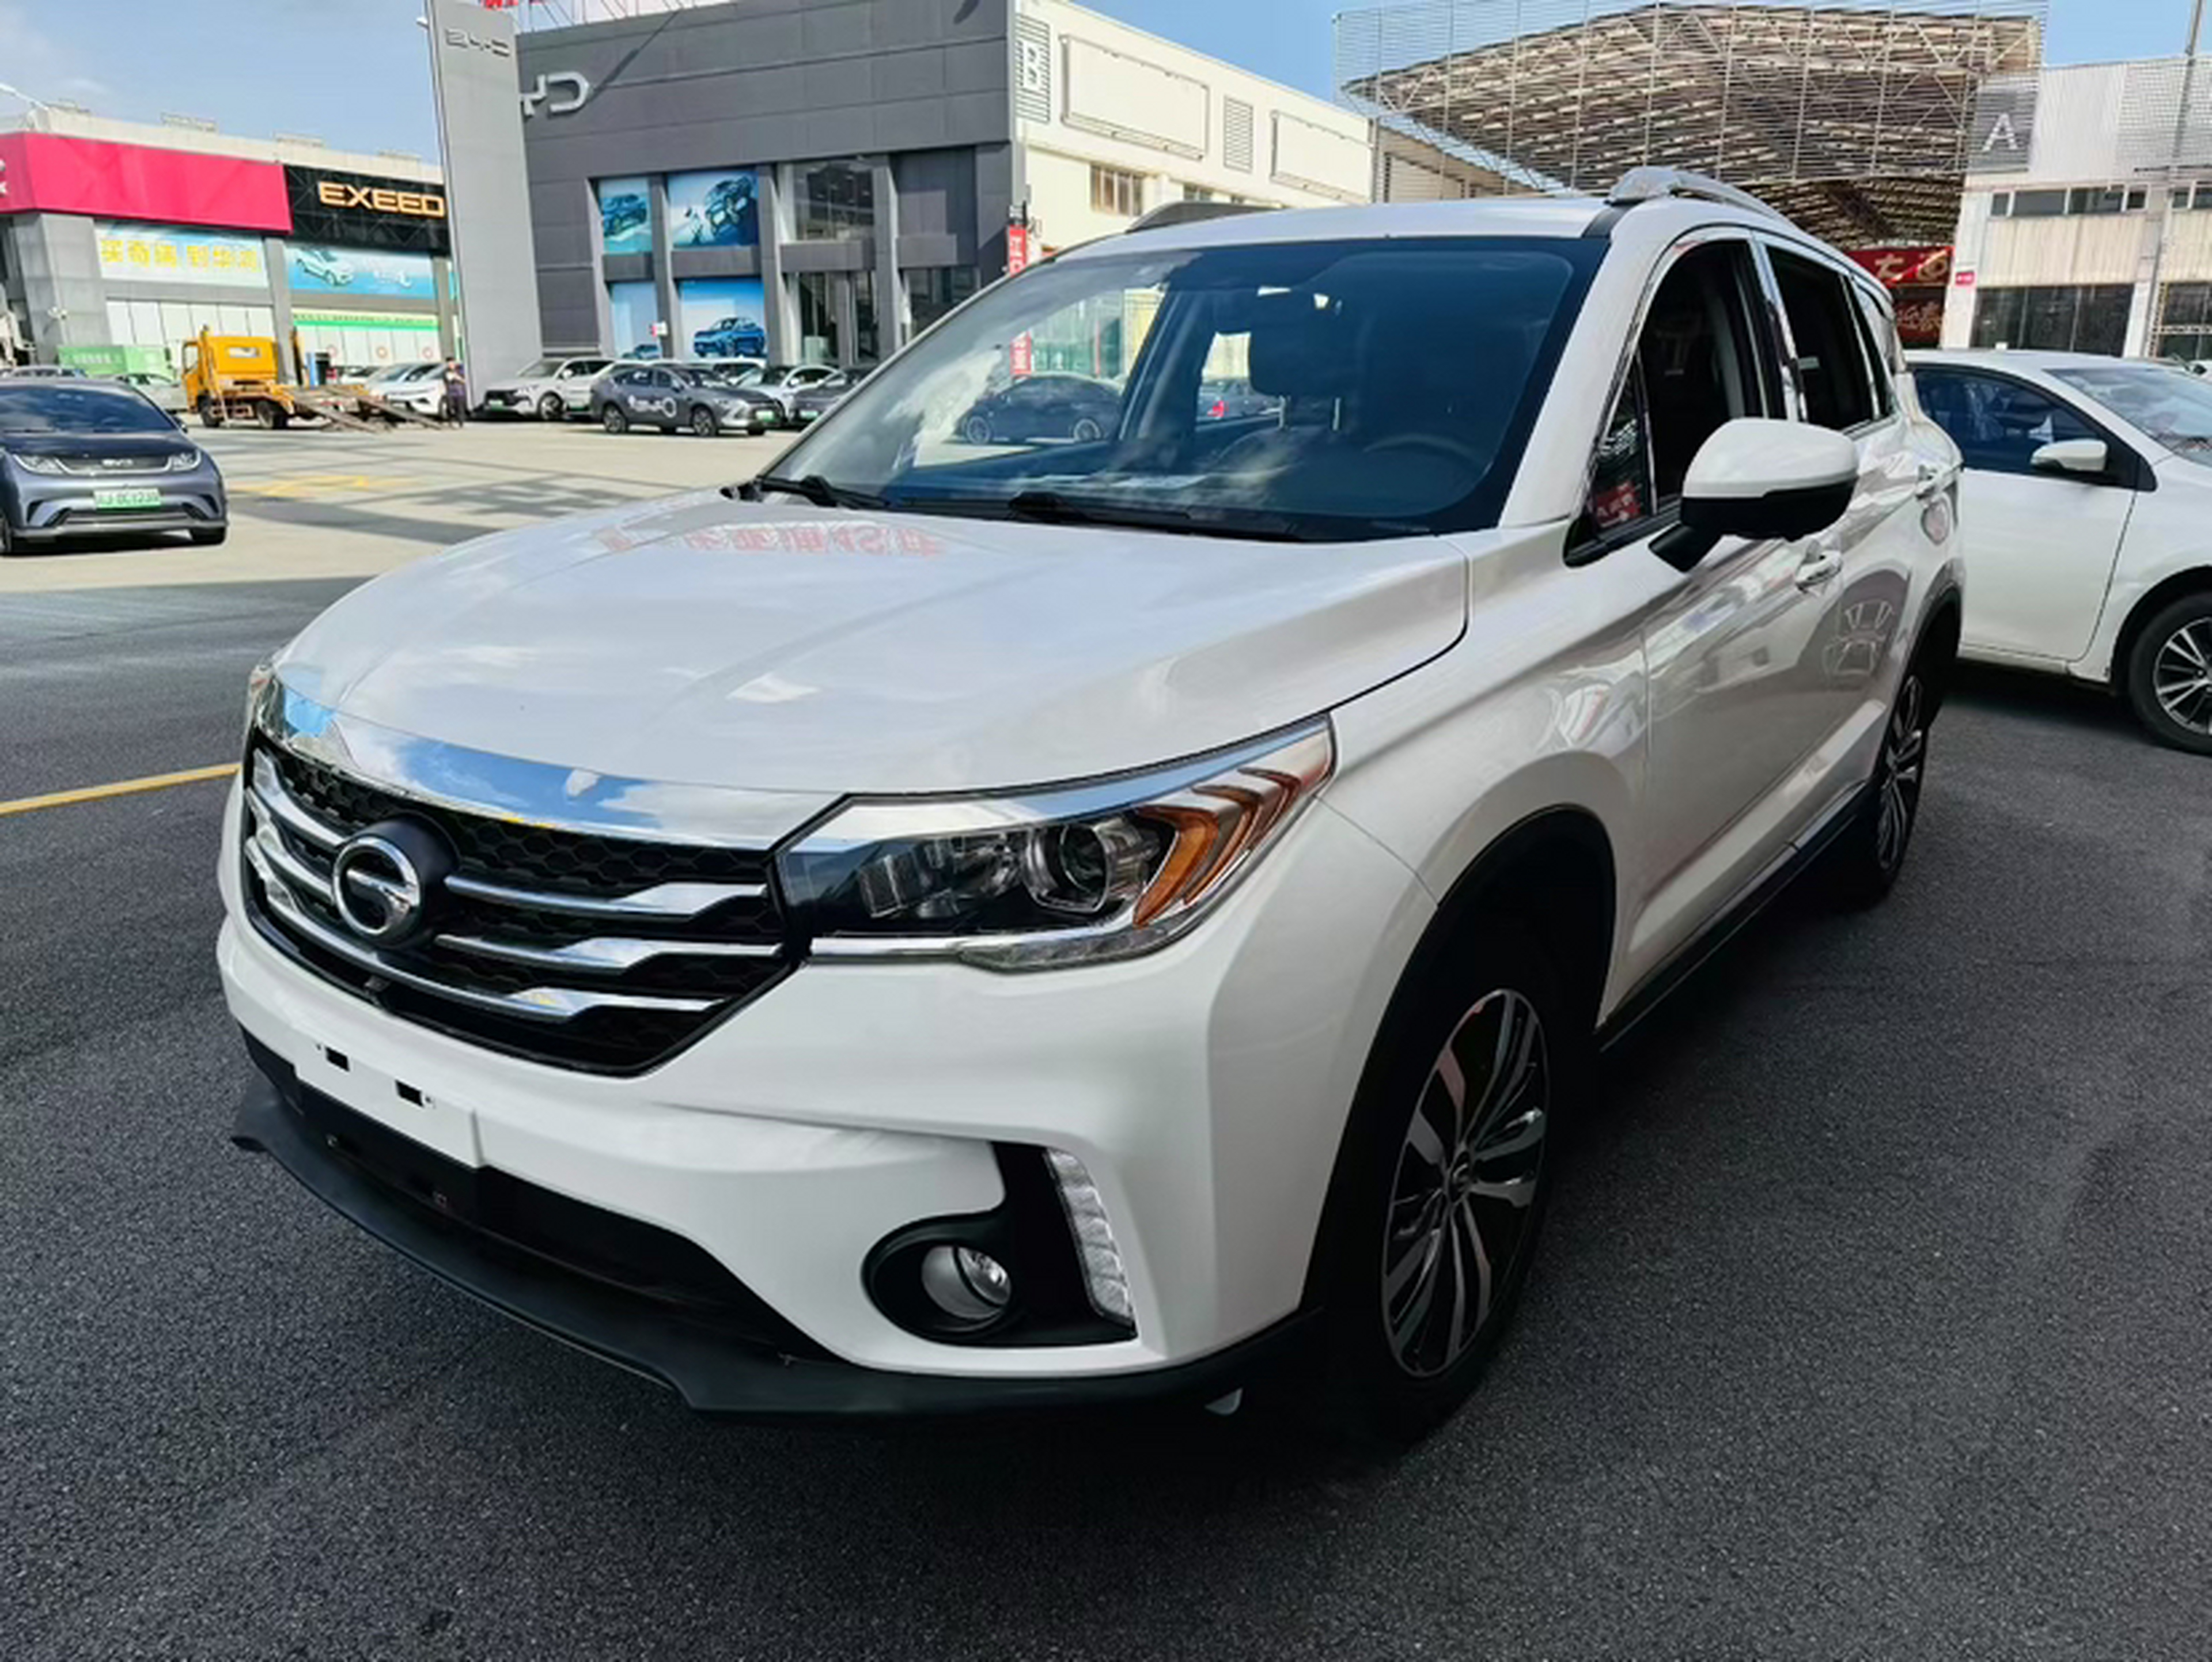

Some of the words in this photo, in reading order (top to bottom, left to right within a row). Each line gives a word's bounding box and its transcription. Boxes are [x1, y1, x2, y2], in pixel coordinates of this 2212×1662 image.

[445, 29, 510, 58] BYD
[520, 71, 589, 115] YD
[1982, 113, 2017, 152] A
[319, 181, 445, 217] EXEED
